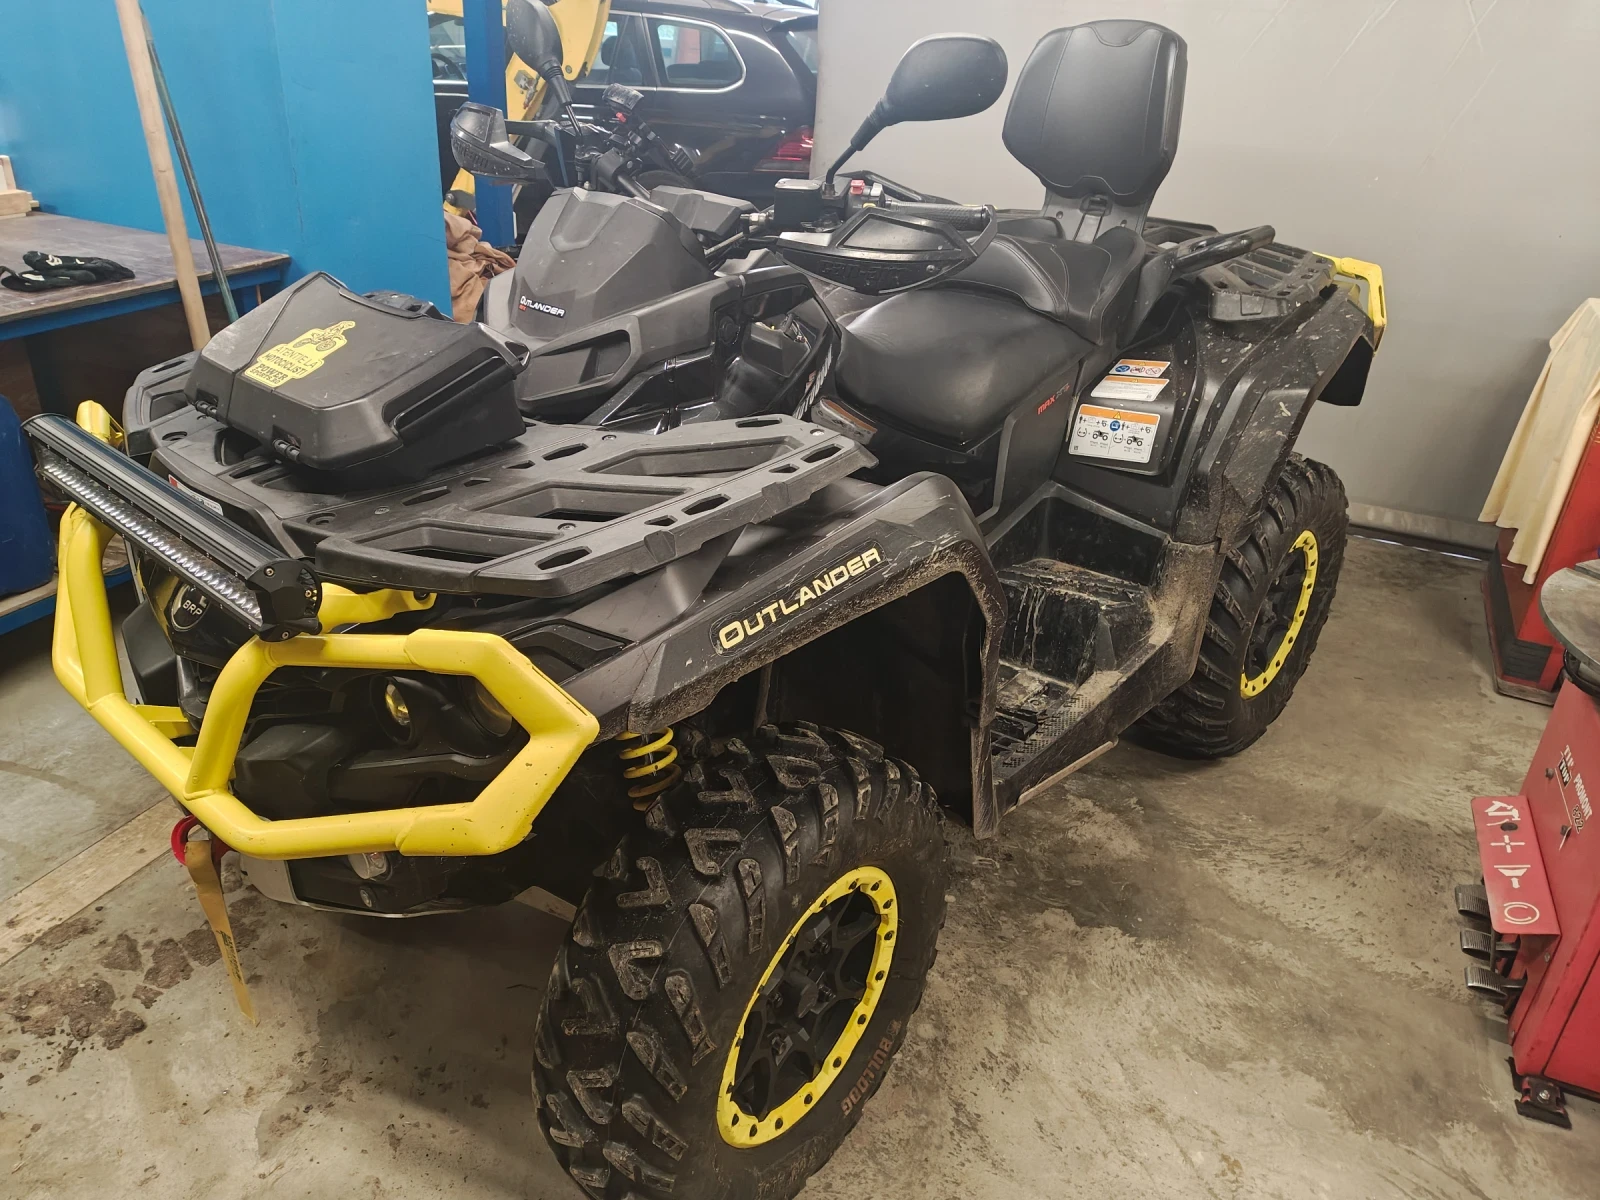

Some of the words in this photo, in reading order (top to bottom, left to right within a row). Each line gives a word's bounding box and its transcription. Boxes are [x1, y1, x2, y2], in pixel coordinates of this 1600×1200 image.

[519, 295, 565, 317] OUTLANDER
[255, 363, 288, 381] POWER
[1037, 394, 1056, 415] MAX
[182, 599, 203, 616] BRP
[718, 547, 882, 650] OUTLANDER
[1573, 772, 1593, 821] PROMONT
[841, 1037, 893, 1117] BULLDOG
